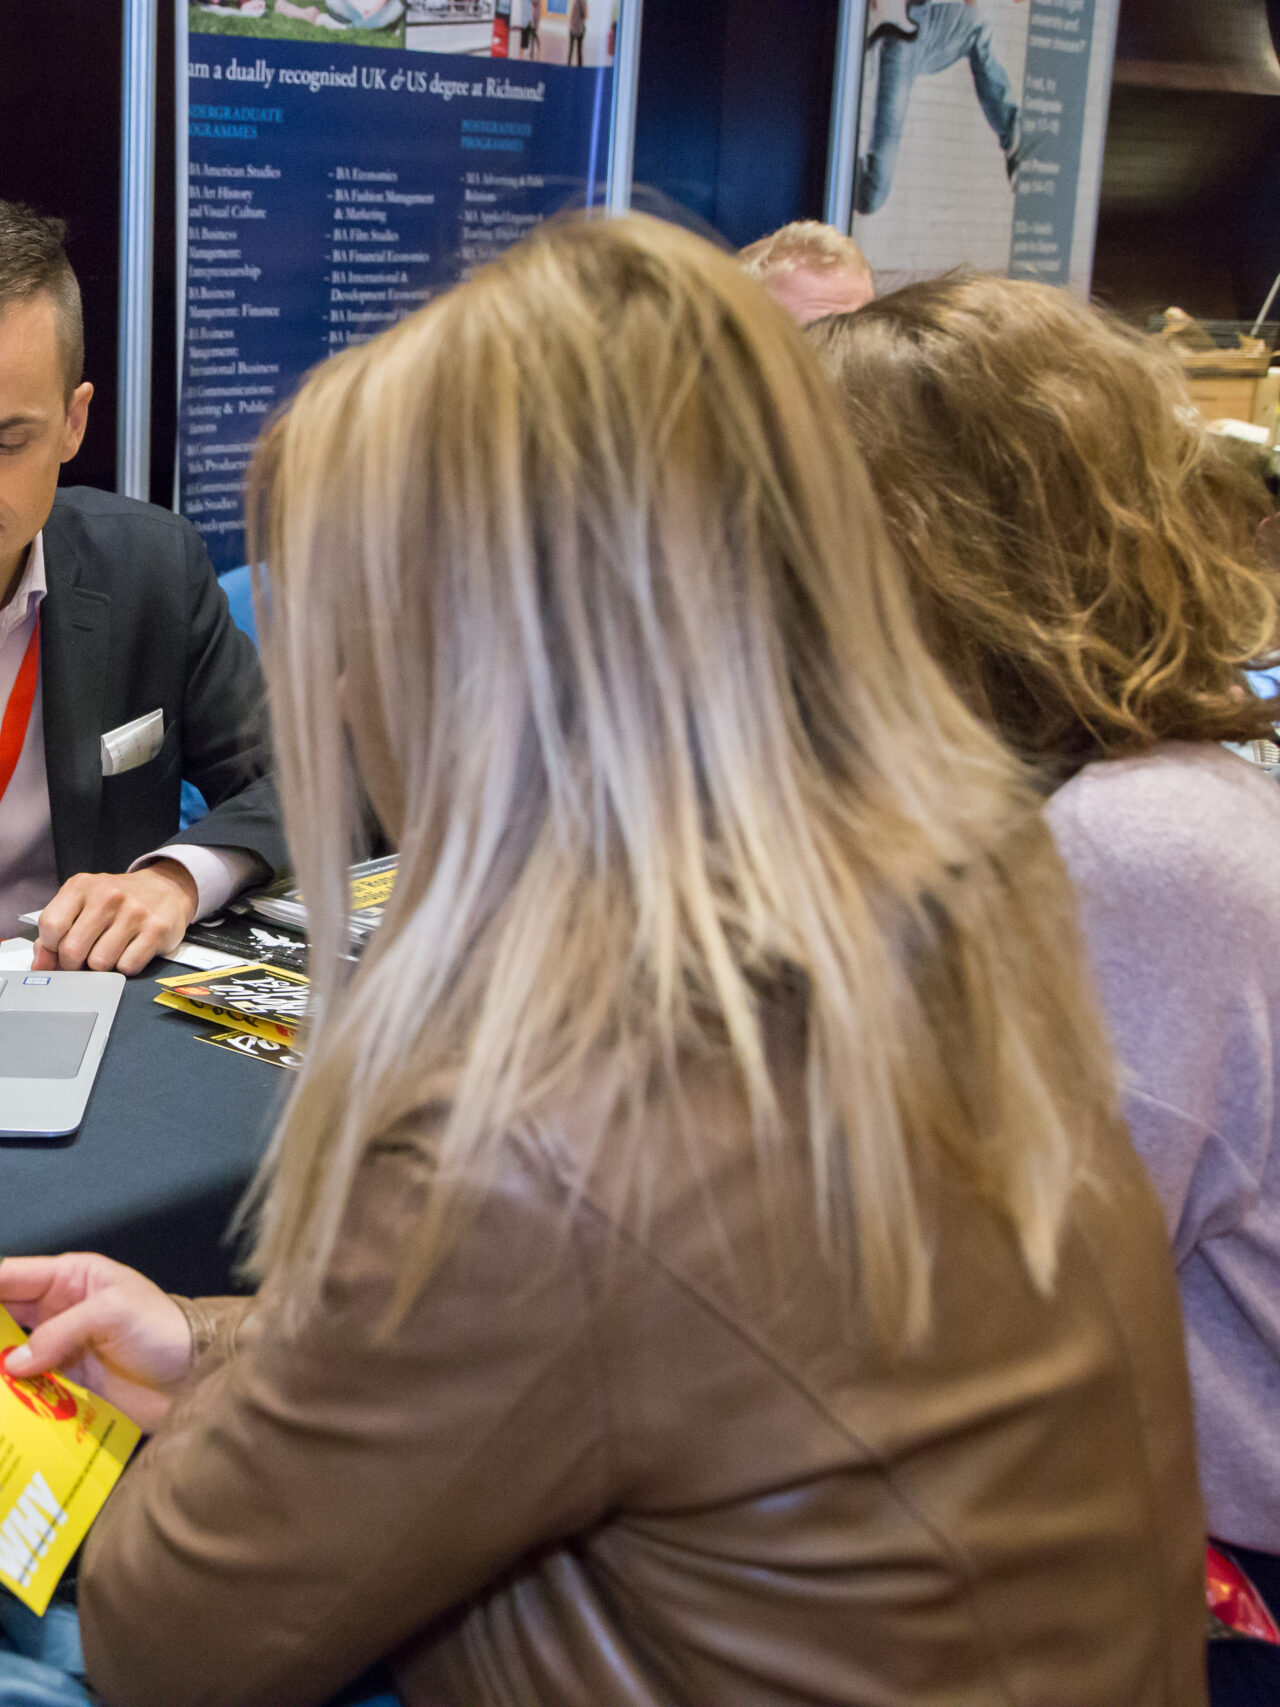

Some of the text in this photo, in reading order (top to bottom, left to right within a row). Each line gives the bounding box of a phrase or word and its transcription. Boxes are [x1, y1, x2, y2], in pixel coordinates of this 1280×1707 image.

[213, 64, 222, 79] a
[225, 58, 275, 88] dually
[278, 65, 357, 92] recognised
[361, 67, 386, 90] UK
[407, 70, 427, 93] US
[429, 72, 469, 101] degree
[471, 82, 482, 97] at
